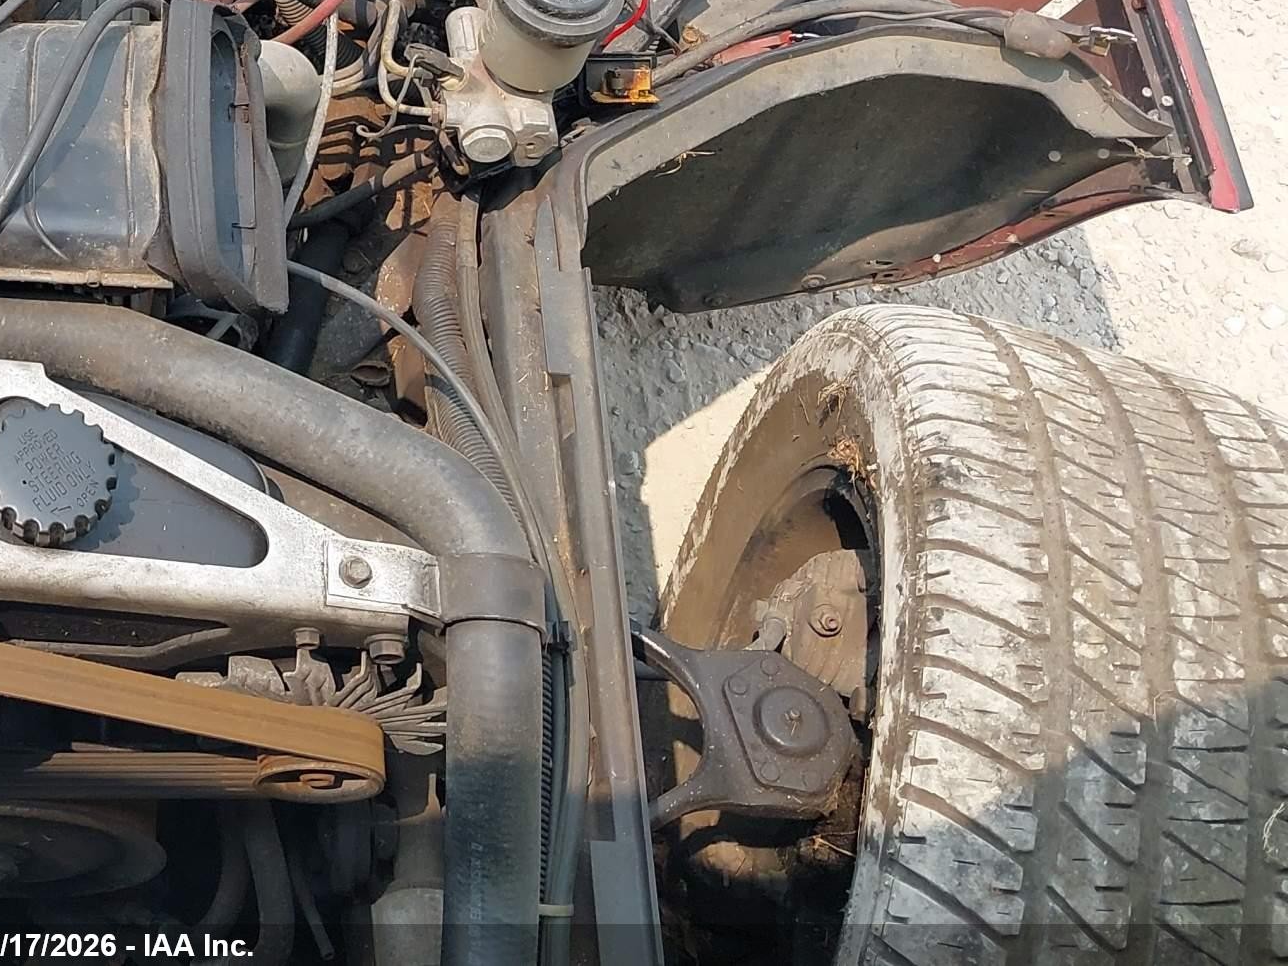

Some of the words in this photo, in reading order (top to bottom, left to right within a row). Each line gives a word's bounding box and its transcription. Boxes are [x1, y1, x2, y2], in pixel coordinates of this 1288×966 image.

[13, 428, 59, 465] APPROVED
[17, 428, 39, 446] USE
[24, 442, 64, 472] POWER
[27, 449, 82, 494] STEERING
[31, 481, 68, 513] FLUID
[65, 460, 98, 488] ONLY
[75, 480, 99, 508] OPEN
